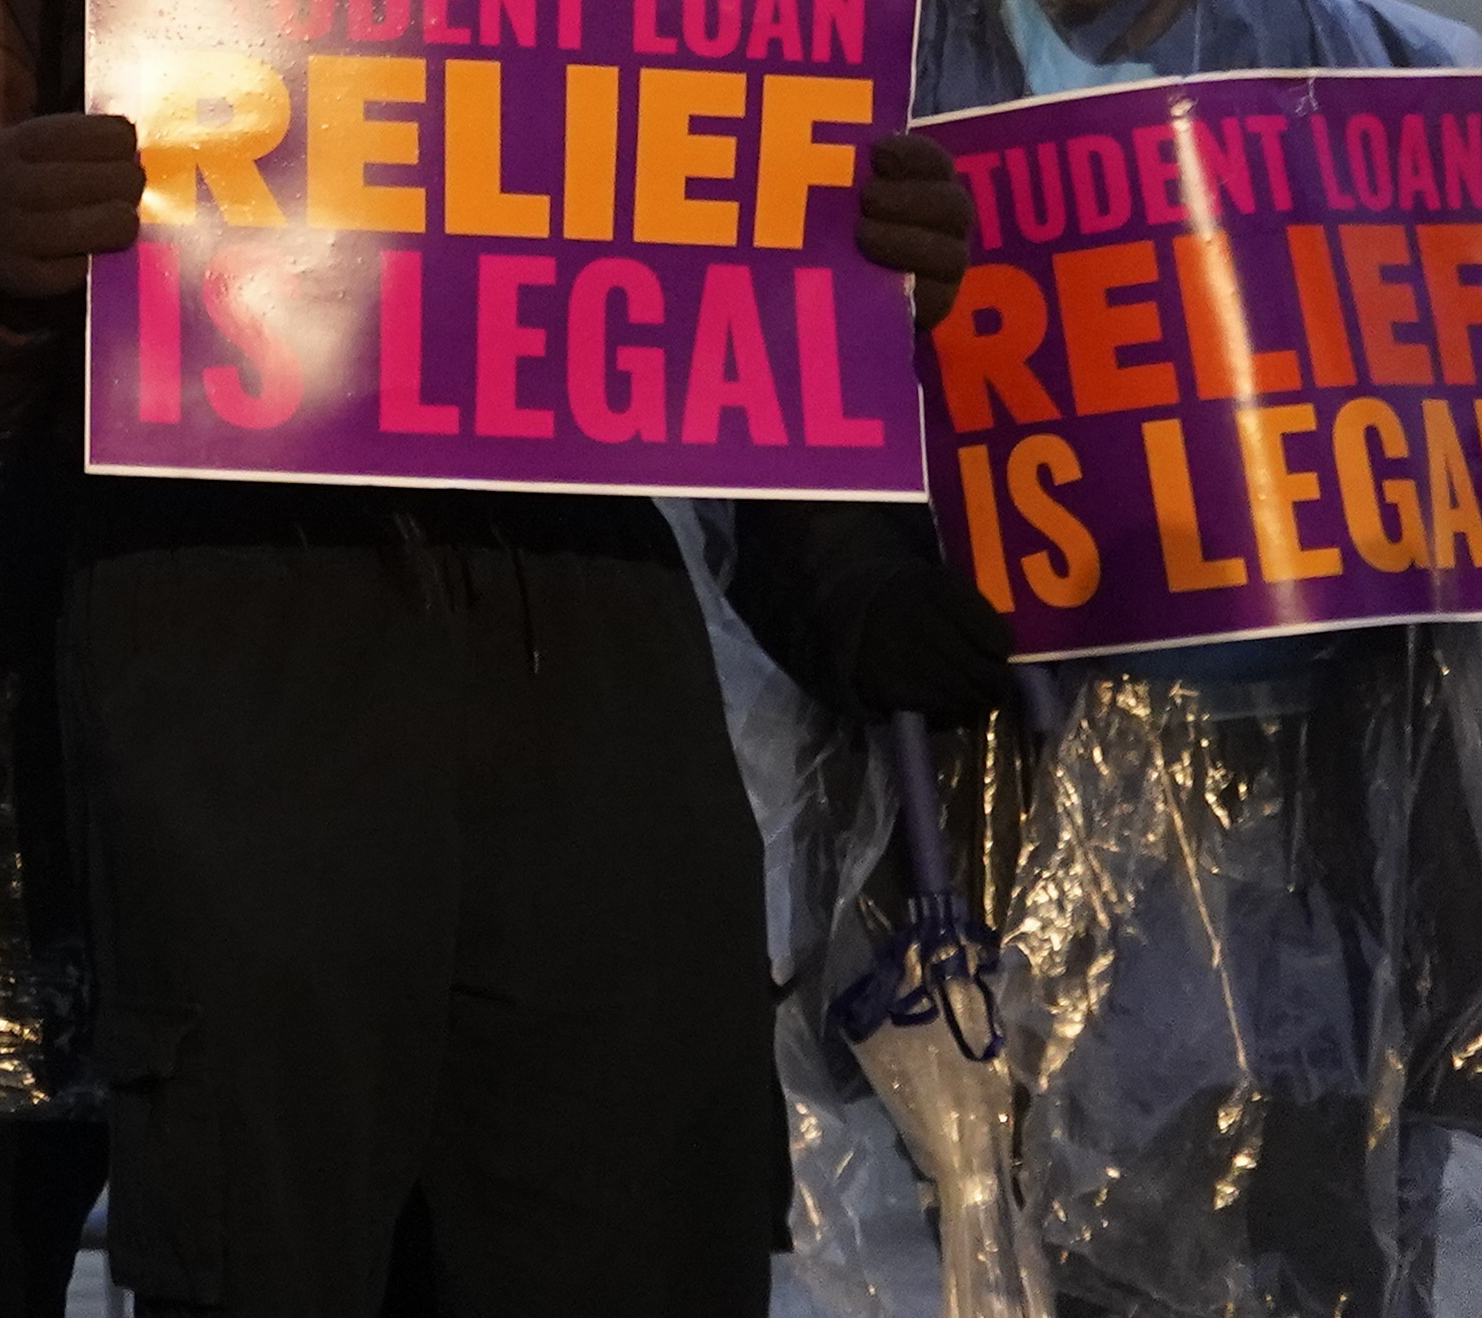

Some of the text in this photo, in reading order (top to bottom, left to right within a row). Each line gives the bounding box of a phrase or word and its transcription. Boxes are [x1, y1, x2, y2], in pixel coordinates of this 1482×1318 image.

[139, 51, 874, 250] RELIEF
[955, 113, 1482, 249] TUDENT LOAN
[138, 242, 885, 448] IS LEGAL
[932, 223, 1482, 432] RELIEF
[957, 397, 1482, 613] IS LEGA
